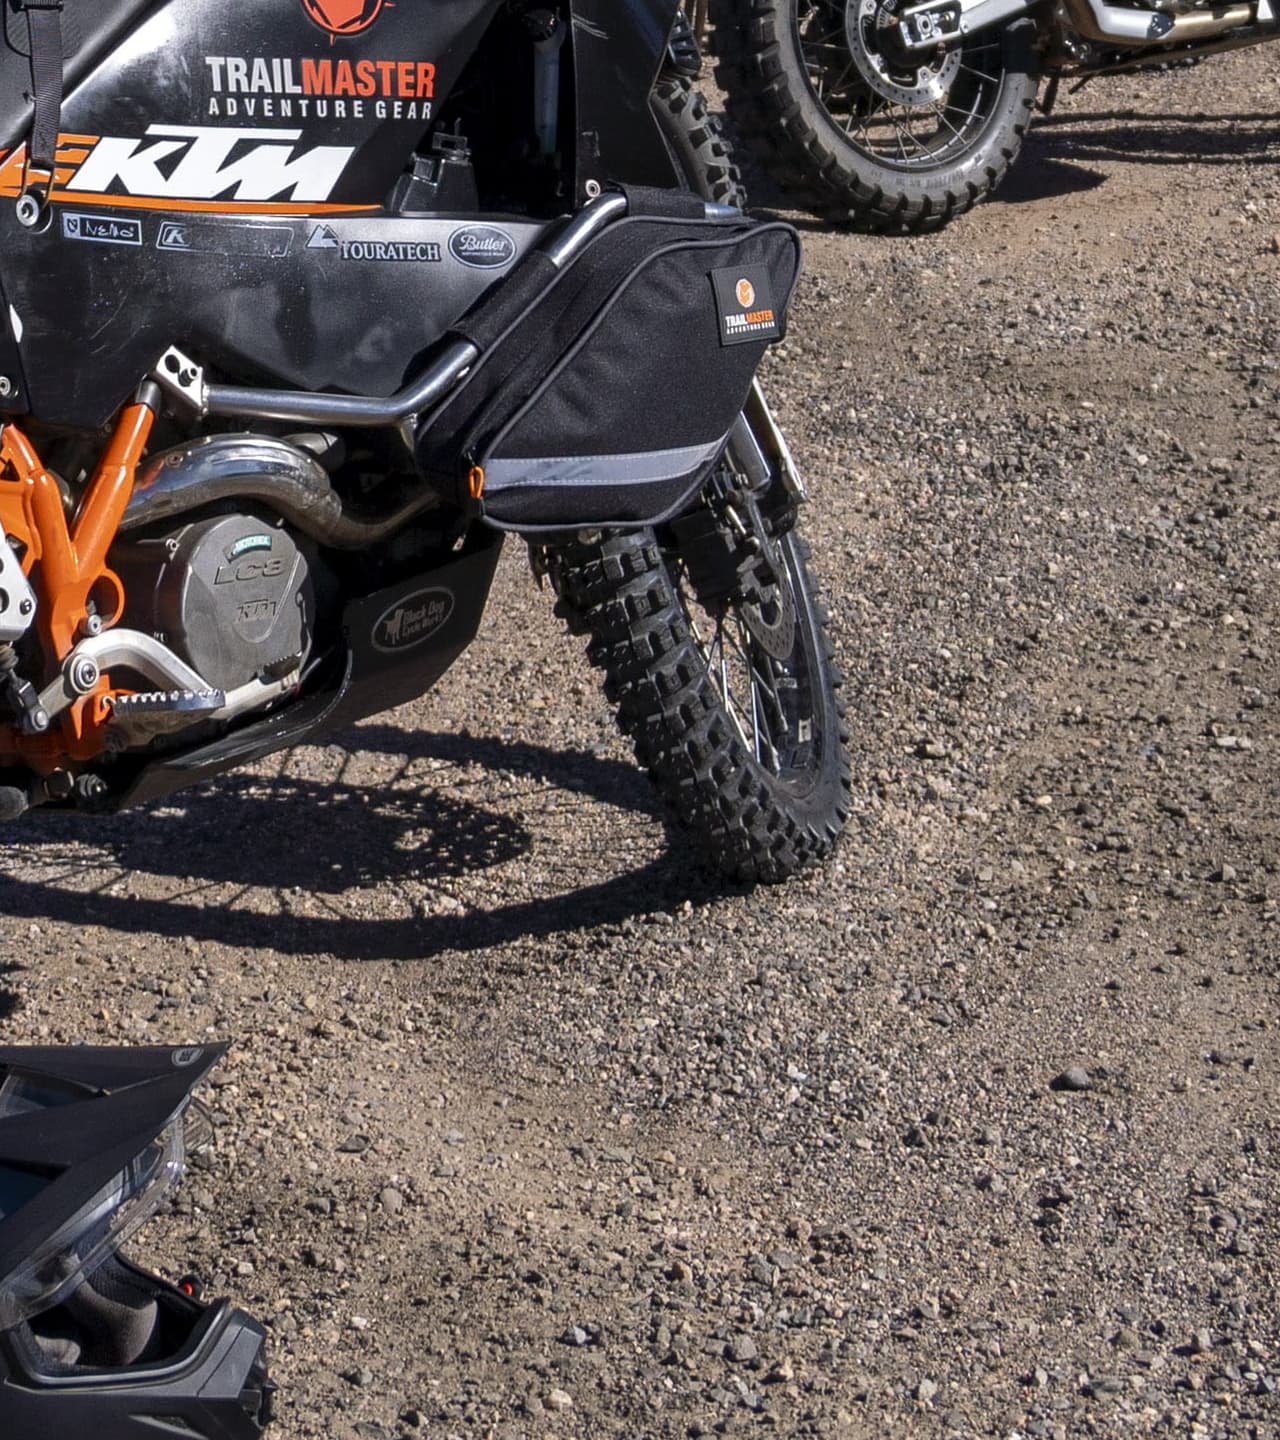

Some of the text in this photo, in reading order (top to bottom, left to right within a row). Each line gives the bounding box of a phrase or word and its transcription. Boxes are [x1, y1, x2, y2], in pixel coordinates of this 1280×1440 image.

[206, 56, 437, 98] TRAILMASTER
[209, 98, 432, 119] ADVENTURE GEAR
[66, 123, 356, 201] KTM
[341, 242, 440, 260] TOURATECH
[459, 234, 508, 251] Butler
